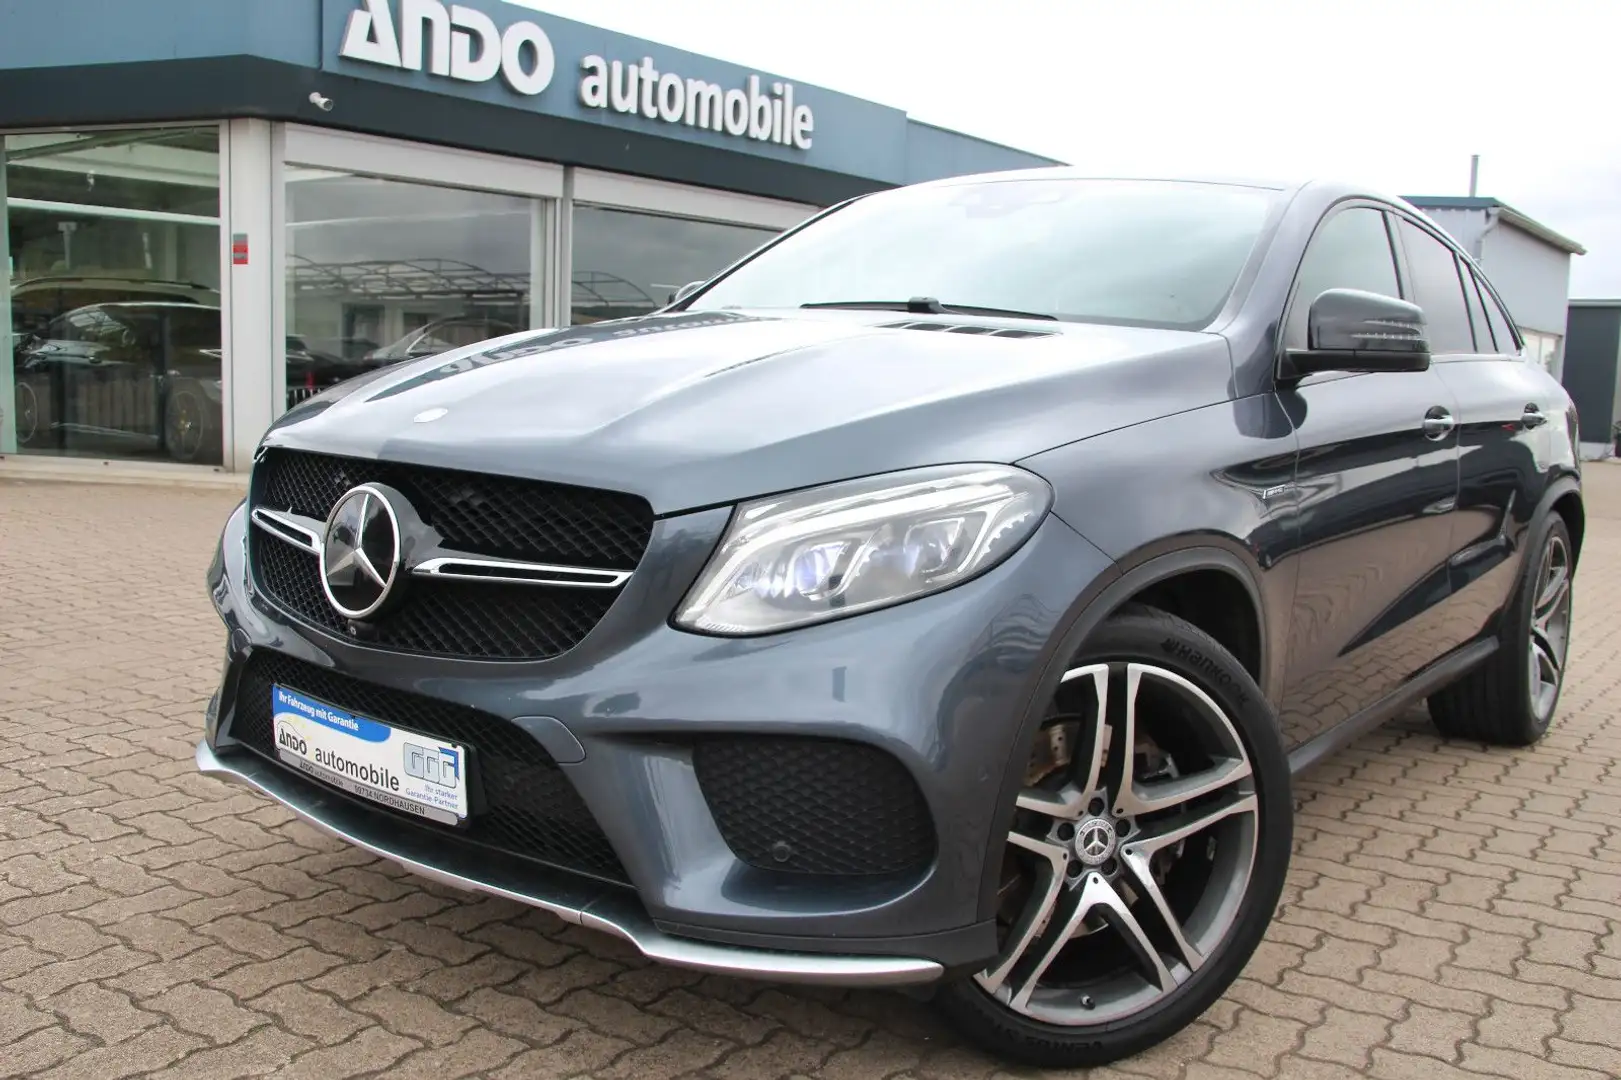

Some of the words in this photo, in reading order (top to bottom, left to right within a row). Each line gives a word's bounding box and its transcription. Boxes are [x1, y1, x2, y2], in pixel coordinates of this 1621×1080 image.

[338, 0, 555, 95] ANDO
[580, 53, 813, 149] automobile
[279, 691, 287, 703] Ihr
[287, 695, 315, 717] Fahrzeug
[315, 705, 327, 720] mit
[327, 712, 359, 731] Garantie
[315, 747, 399, 791] automobile
[374, 790, 425, 815] NORDHAUSEN
